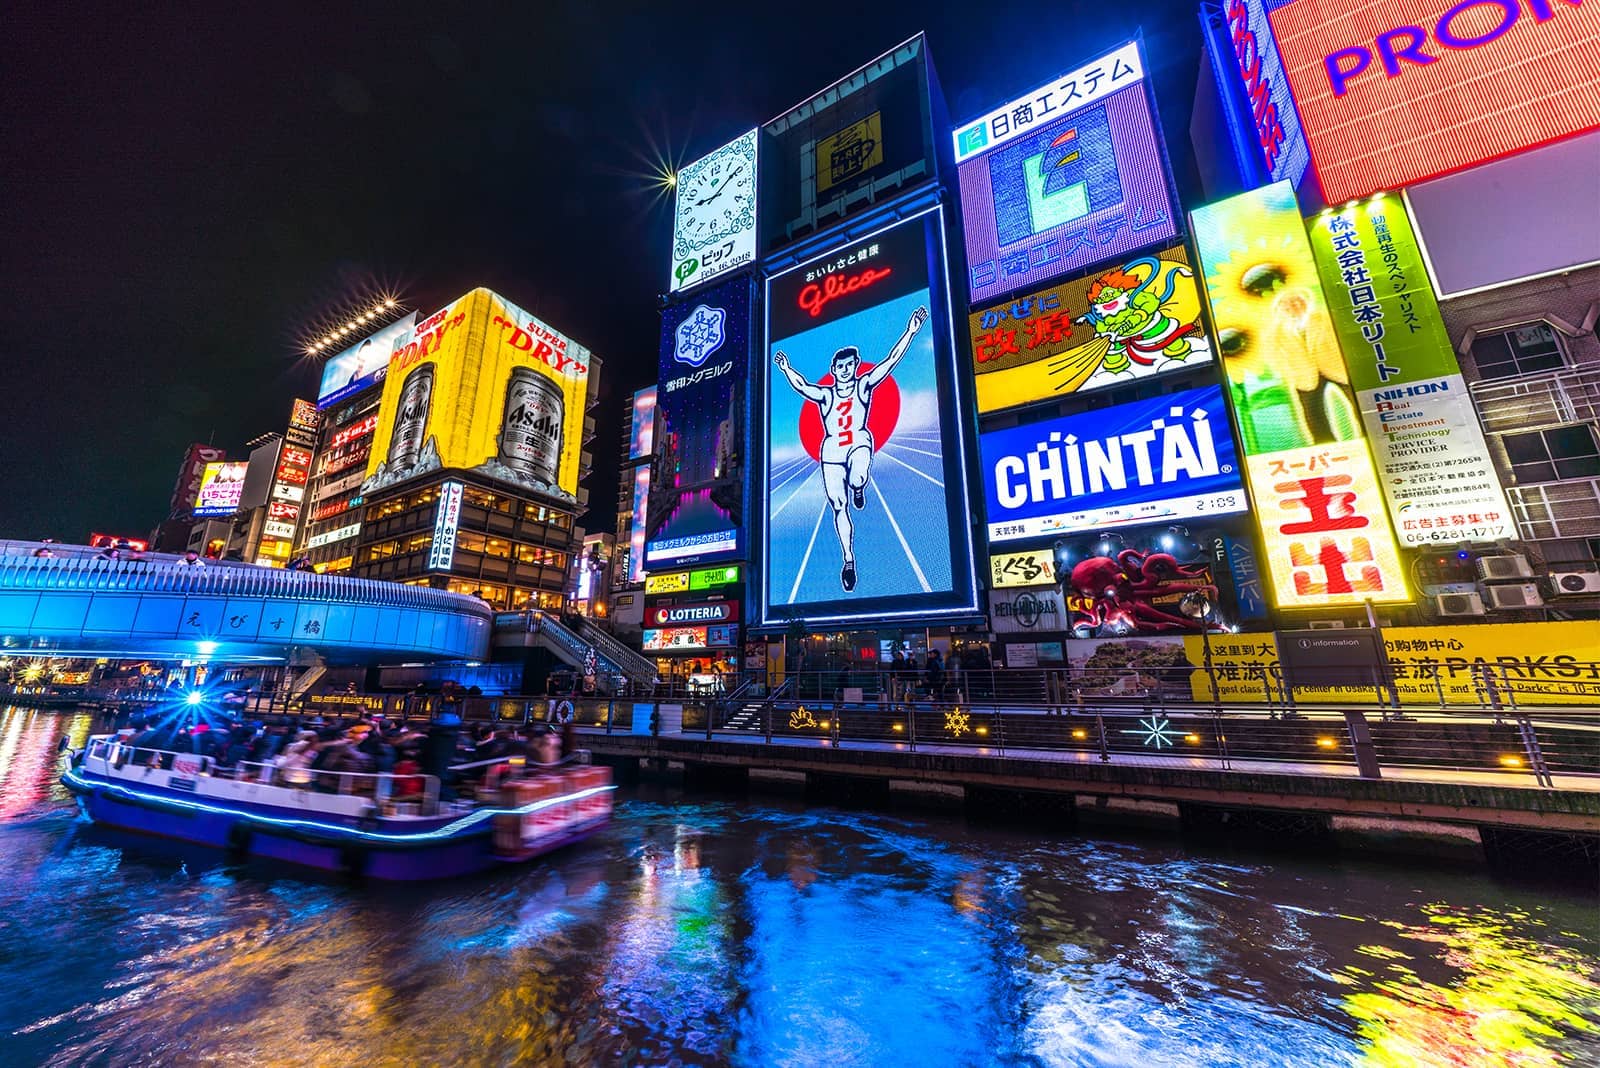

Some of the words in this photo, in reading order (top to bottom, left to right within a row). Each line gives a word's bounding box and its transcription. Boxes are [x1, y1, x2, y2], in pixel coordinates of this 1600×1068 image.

[991, 58, 1135, 140] 日商エステム
[702, 240, 735, 267] ピップ
[971, 206, 1170, 289] 日商エステム
[806, 244, 879, 282] おいしさと健康
[798, 265, 891, 317] Glico
[1329, 215, 1401, 383] 株式会社日本リート
[415, 309, 448, 337] SUPER
[980, 293, 1061, 331] かぜに
[527, 321, 567, 352] SUPER
[974, 307, 1074, 364] 改源
[666, 361, 733, 392] 雪印メグミルク
[1374, 381, 1448, 402] NIHON
[1376, 400, 1411, 412] Real
[1380, 411, 1424, 422] Estate
[509, 403, 560, 441] Asahi
[836, 397, 853, 447] グリコ
[1382, 418, 1446, 433] Investment
[1384, 428, 1450, 442] Technology
[1388, 438, 1436, 451] SERVICE
[994, 406, 1220, 509] CHINTAI
[1391, 444, 1449, 457] PROVIDER
[1268, 452, 1349, 476] スーパー
[995, 523, 1026, 536] 天気予報
[1403, 511, 1500, 531] 広告主募集中
[1406, 526, 1505, 543] 06-6281-1717
[1214, 538, 1225, 561] 2F
[1003, 556, 1042, 580] くくる
[186, 611, 321, 635] えびす橋
[670, 606, 722, 620] LOTTERIA
[1312, 638, 1360, 647] information
[1208, 684, 1239, 695] Lrgest
[1450, 684, 1470, 694] and
